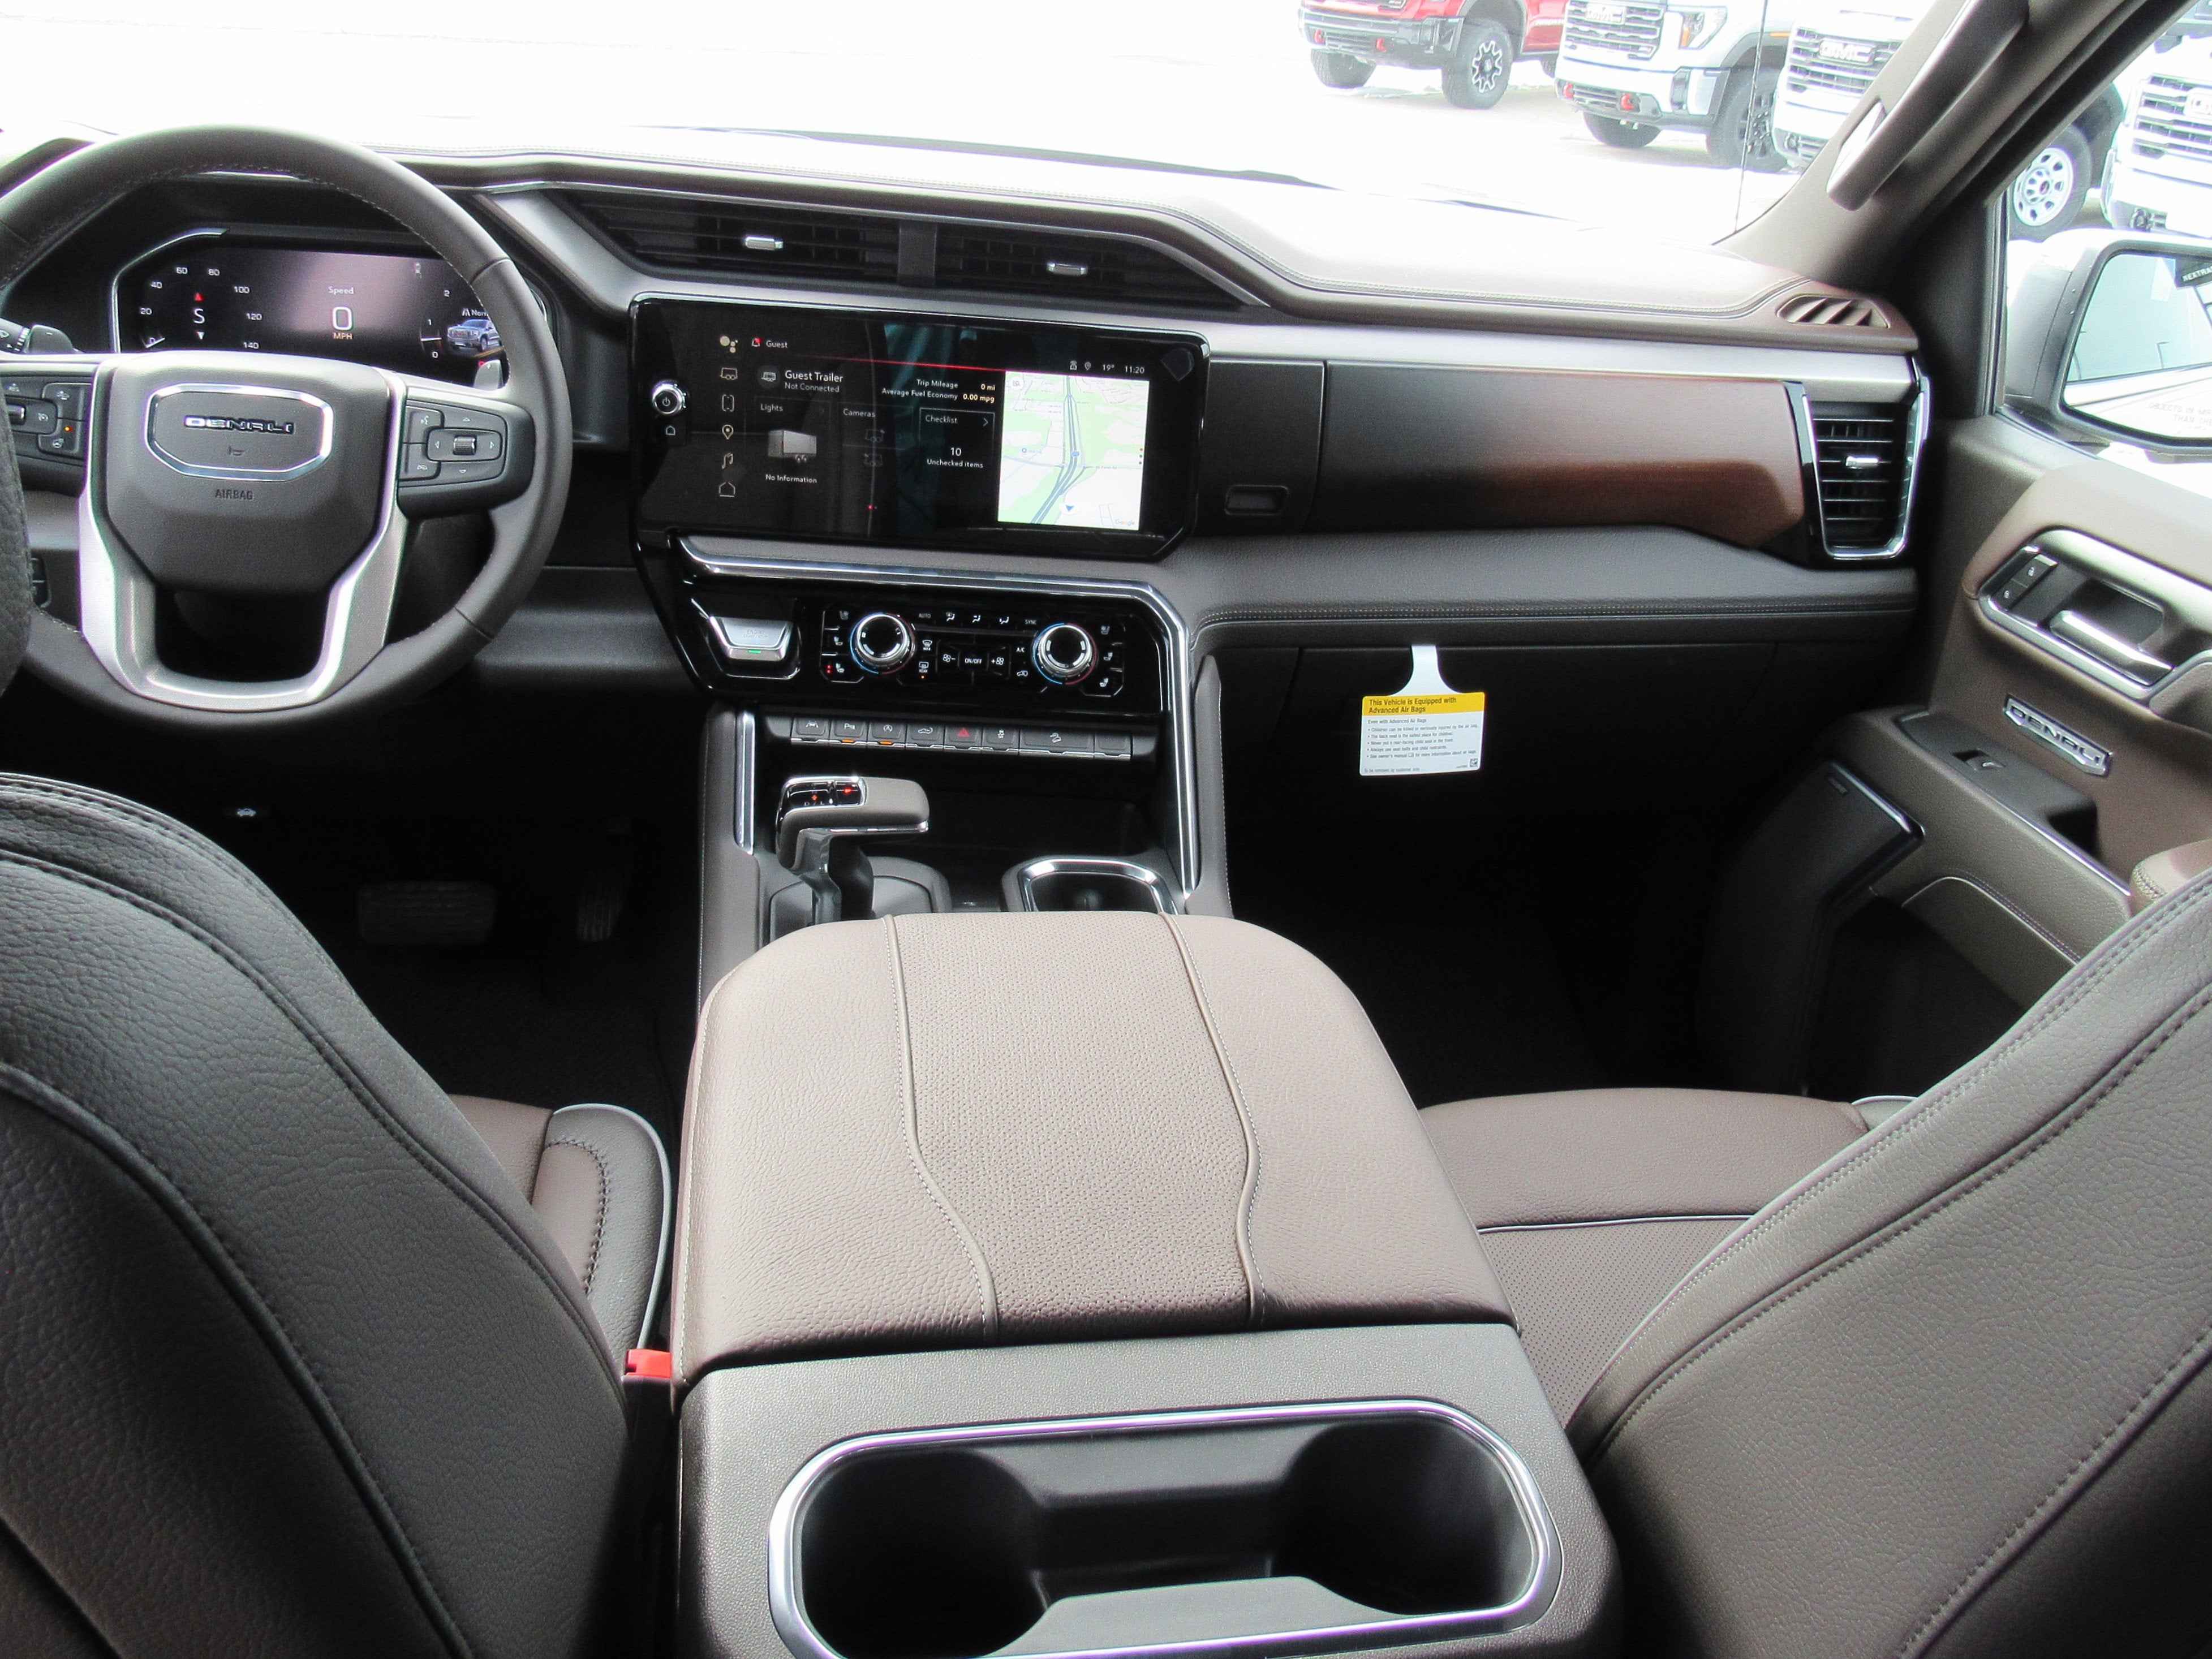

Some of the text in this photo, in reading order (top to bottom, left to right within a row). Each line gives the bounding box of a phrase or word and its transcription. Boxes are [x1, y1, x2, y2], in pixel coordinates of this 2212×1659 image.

[1586, 5, 1622, 22] GMC
[1819, 40, 1871, 63] GMC
[233, 286, 250, 294] 100
[328, 286, 354, 295] Speed
[193, 308, 205, 324] S
[246, 312, 262, 321] 120
[332, 306, 353, 331] 0
[1125, 365, 1145, 374] 11:20
[785, 370, 844, 382] Guest Trailer
[800, 383, 840, 393] Connected
[931, 380, 958, 389] Mileage
[882, 388, 909, 397] Average
[927, 391, 958, 401] Economy
[760, 403, 784, 413] Lights
[843, 408, 876, 418] Cameras
[184, 415, 295, 434] DENALI
[925, 415, 958, 424] Checklist
[950, 447, 962, 456] 10
[927, 459, 963, 467] Unchecked
[777, 475, 817, 484] Information
[215, 489, 253, 500] AIRBAG
[1114, 518, 1135, 527] Google
[2009, 705, 2100, 764] DENALI
